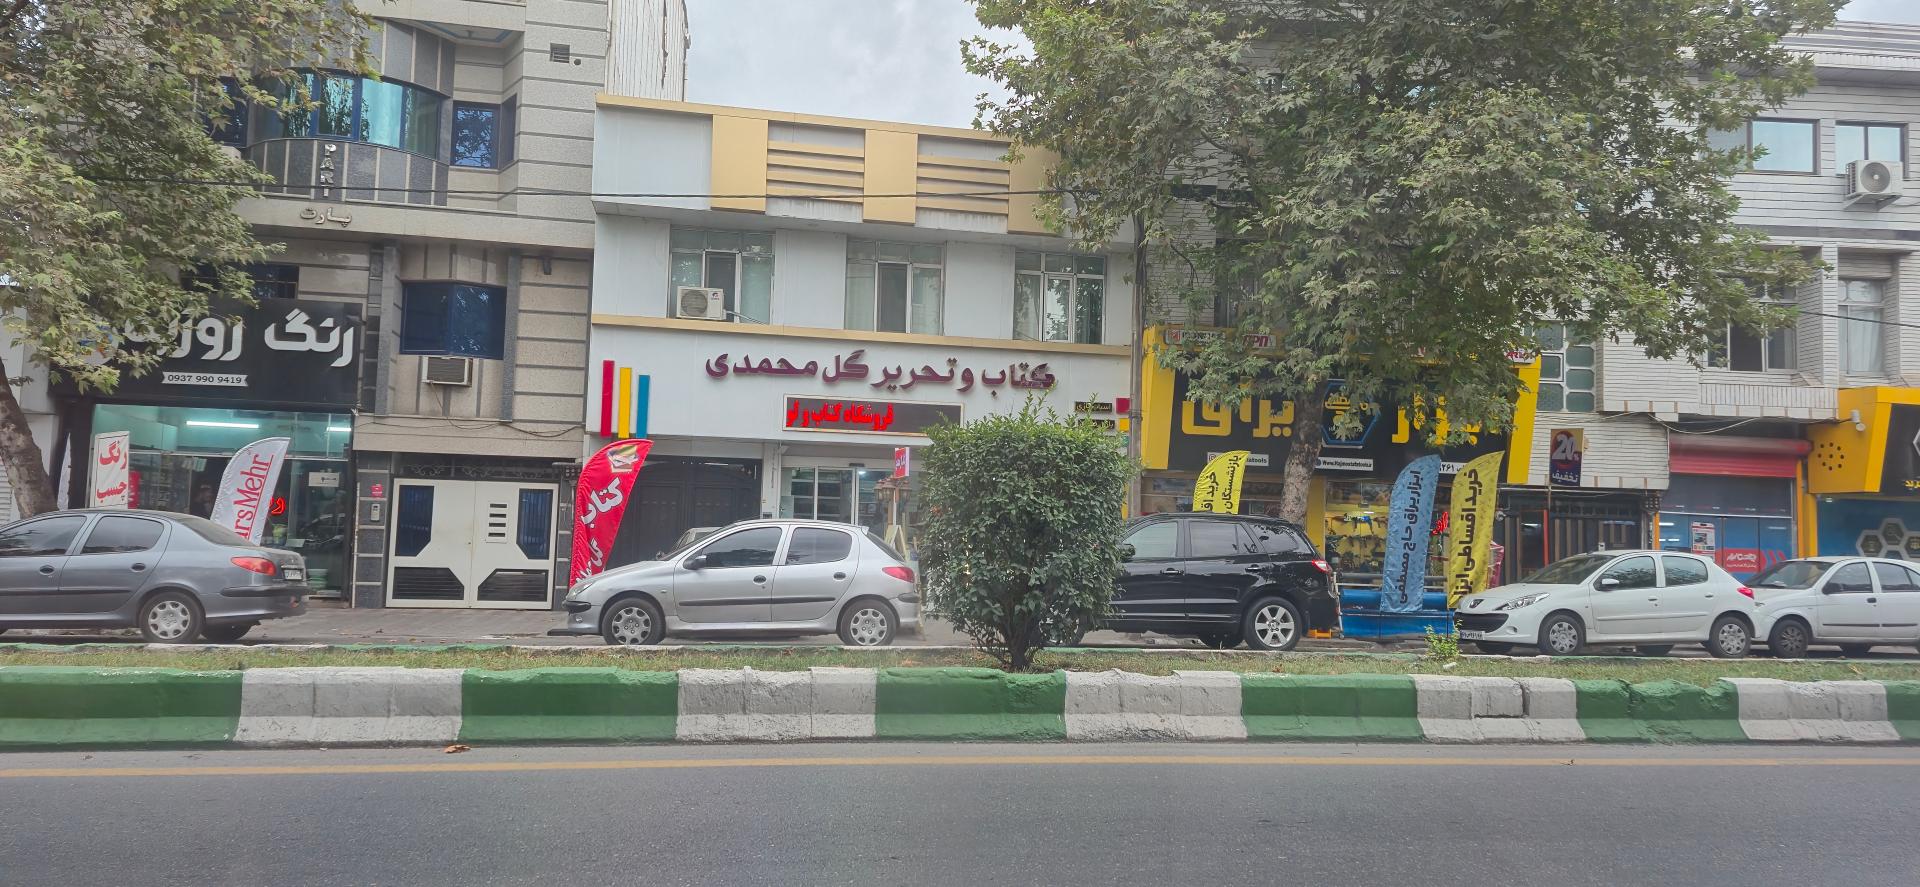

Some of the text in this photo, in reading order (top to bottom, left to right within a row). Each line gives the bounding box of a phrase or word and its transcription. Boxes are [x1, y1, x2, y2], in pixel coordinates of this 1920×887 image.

[300, 207, 352, 228] پارت
[264, 308, 355, 368] رنگ
[167, 374, 242, 384] 0937 990 9419
[705, 349, 1056, 397] کتاب و تحریر گل محمدی
[811, 402, 843, 426] کتاب
[843, 401, 895, 431] فروشگاه
[99, 440, 128, 470] رنگ
[96, 481, 128, 504] چسب
[1205, 472, 1220, 498] خرید
[1463, 468, 1484, 507] خرید
[1552, 471, 1580, 484] تخفیف
[580, 477, 624, 529] کتاب
[1396, 470, 1424, 604] ابزار یراق حاج مصطفی
[1457, 507, 1477, 572] اقساطی
[588, 538, 604, 567] گل
